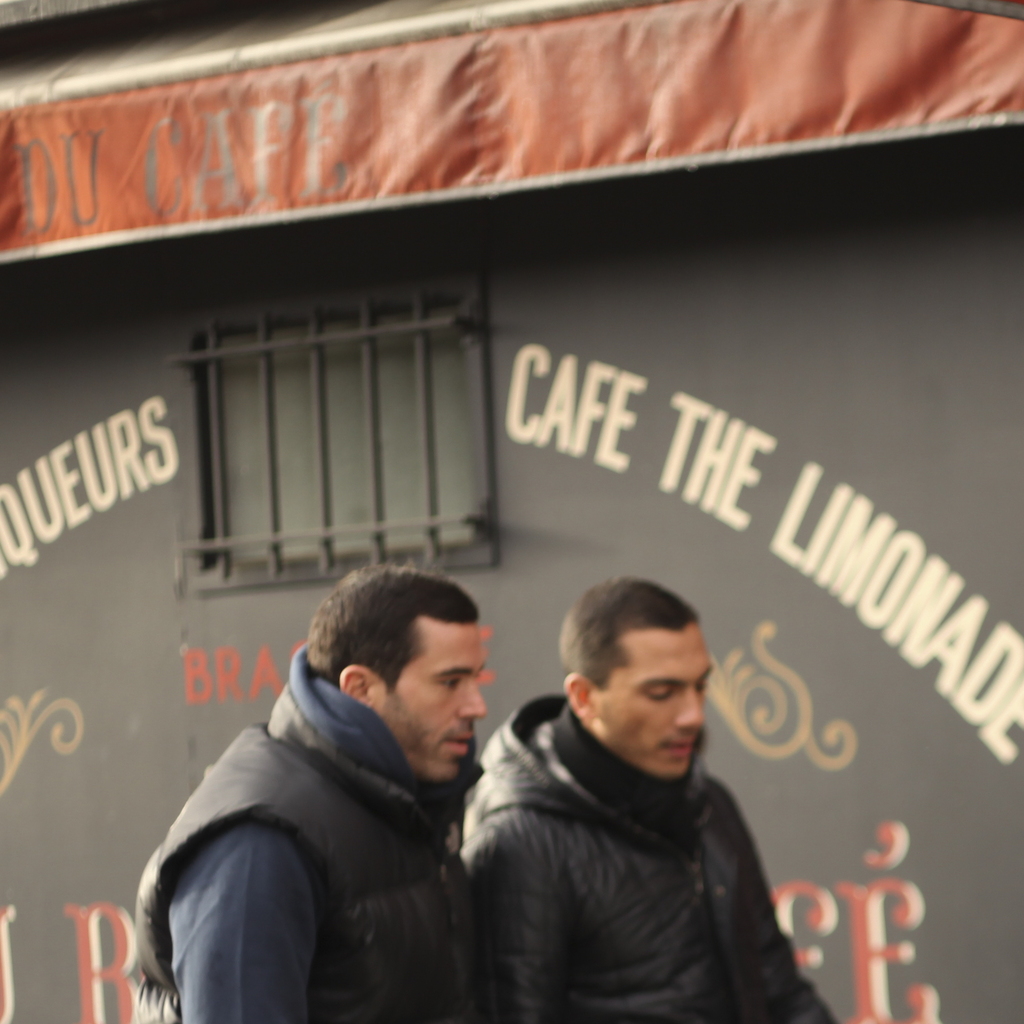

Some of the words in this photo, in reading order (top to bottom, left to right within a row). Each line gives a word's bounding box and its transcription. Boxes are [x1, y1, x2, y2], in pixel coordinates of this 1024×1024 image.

[13, 128, 105, 236] DU
[505, 343, 648, 474] CAFE
[657, 391, 778, 532] THE
